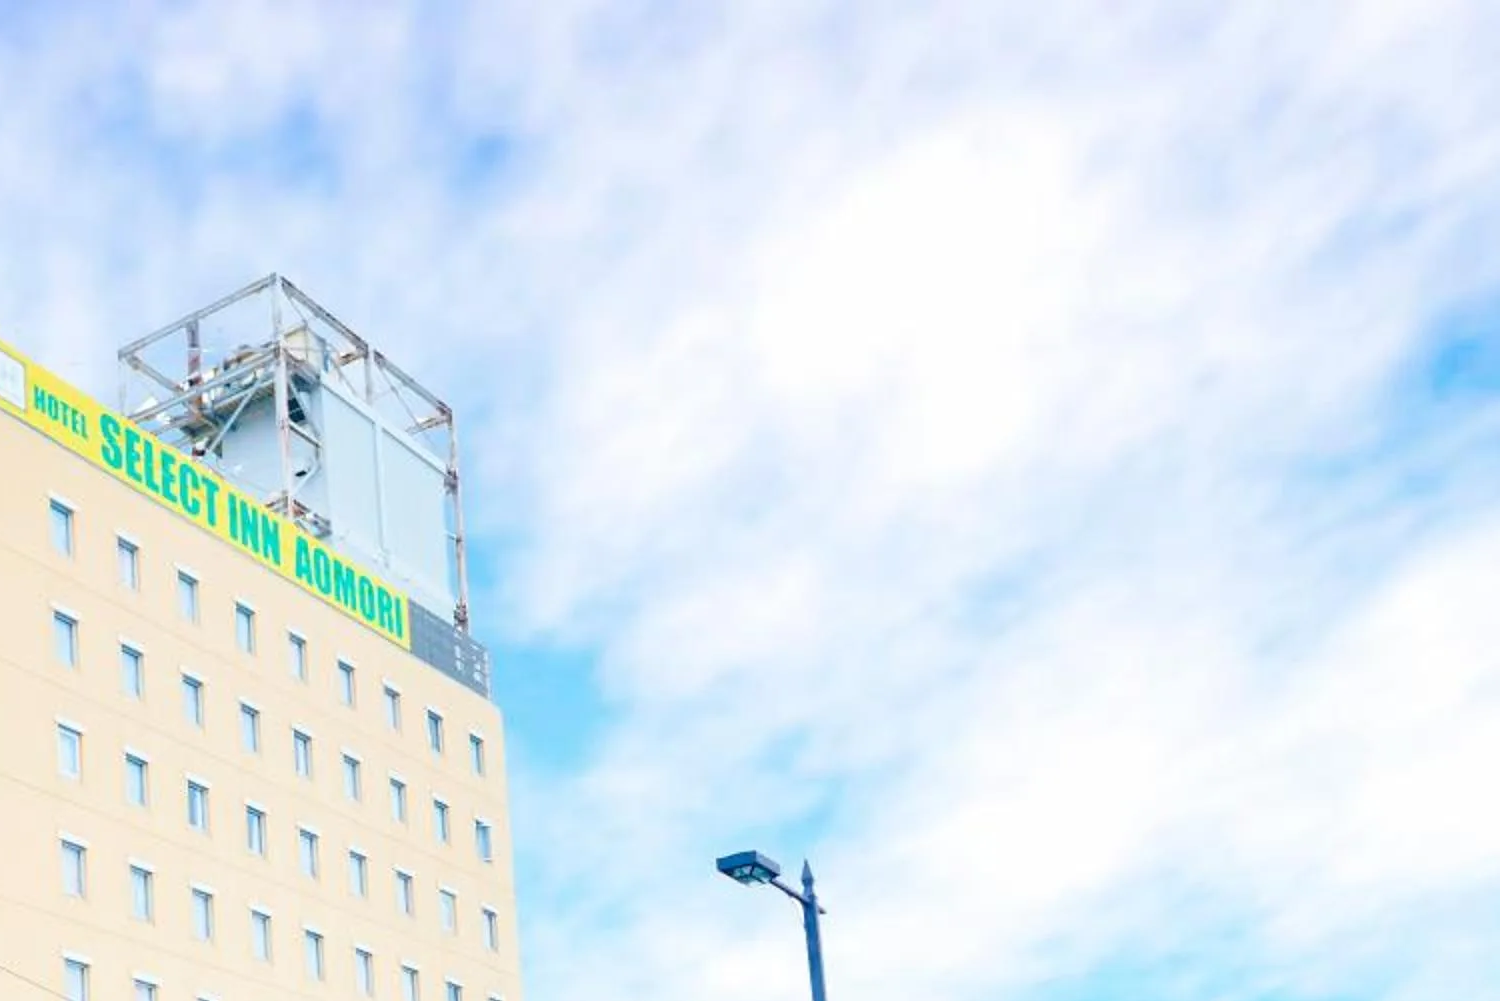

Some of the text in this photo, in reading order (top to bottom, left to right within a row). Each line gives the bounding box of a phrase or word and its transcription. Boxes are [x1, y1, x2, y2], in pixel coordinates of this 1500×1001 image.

[33, 384, 404, 640] HOTEL SELECT INN AOMORI
